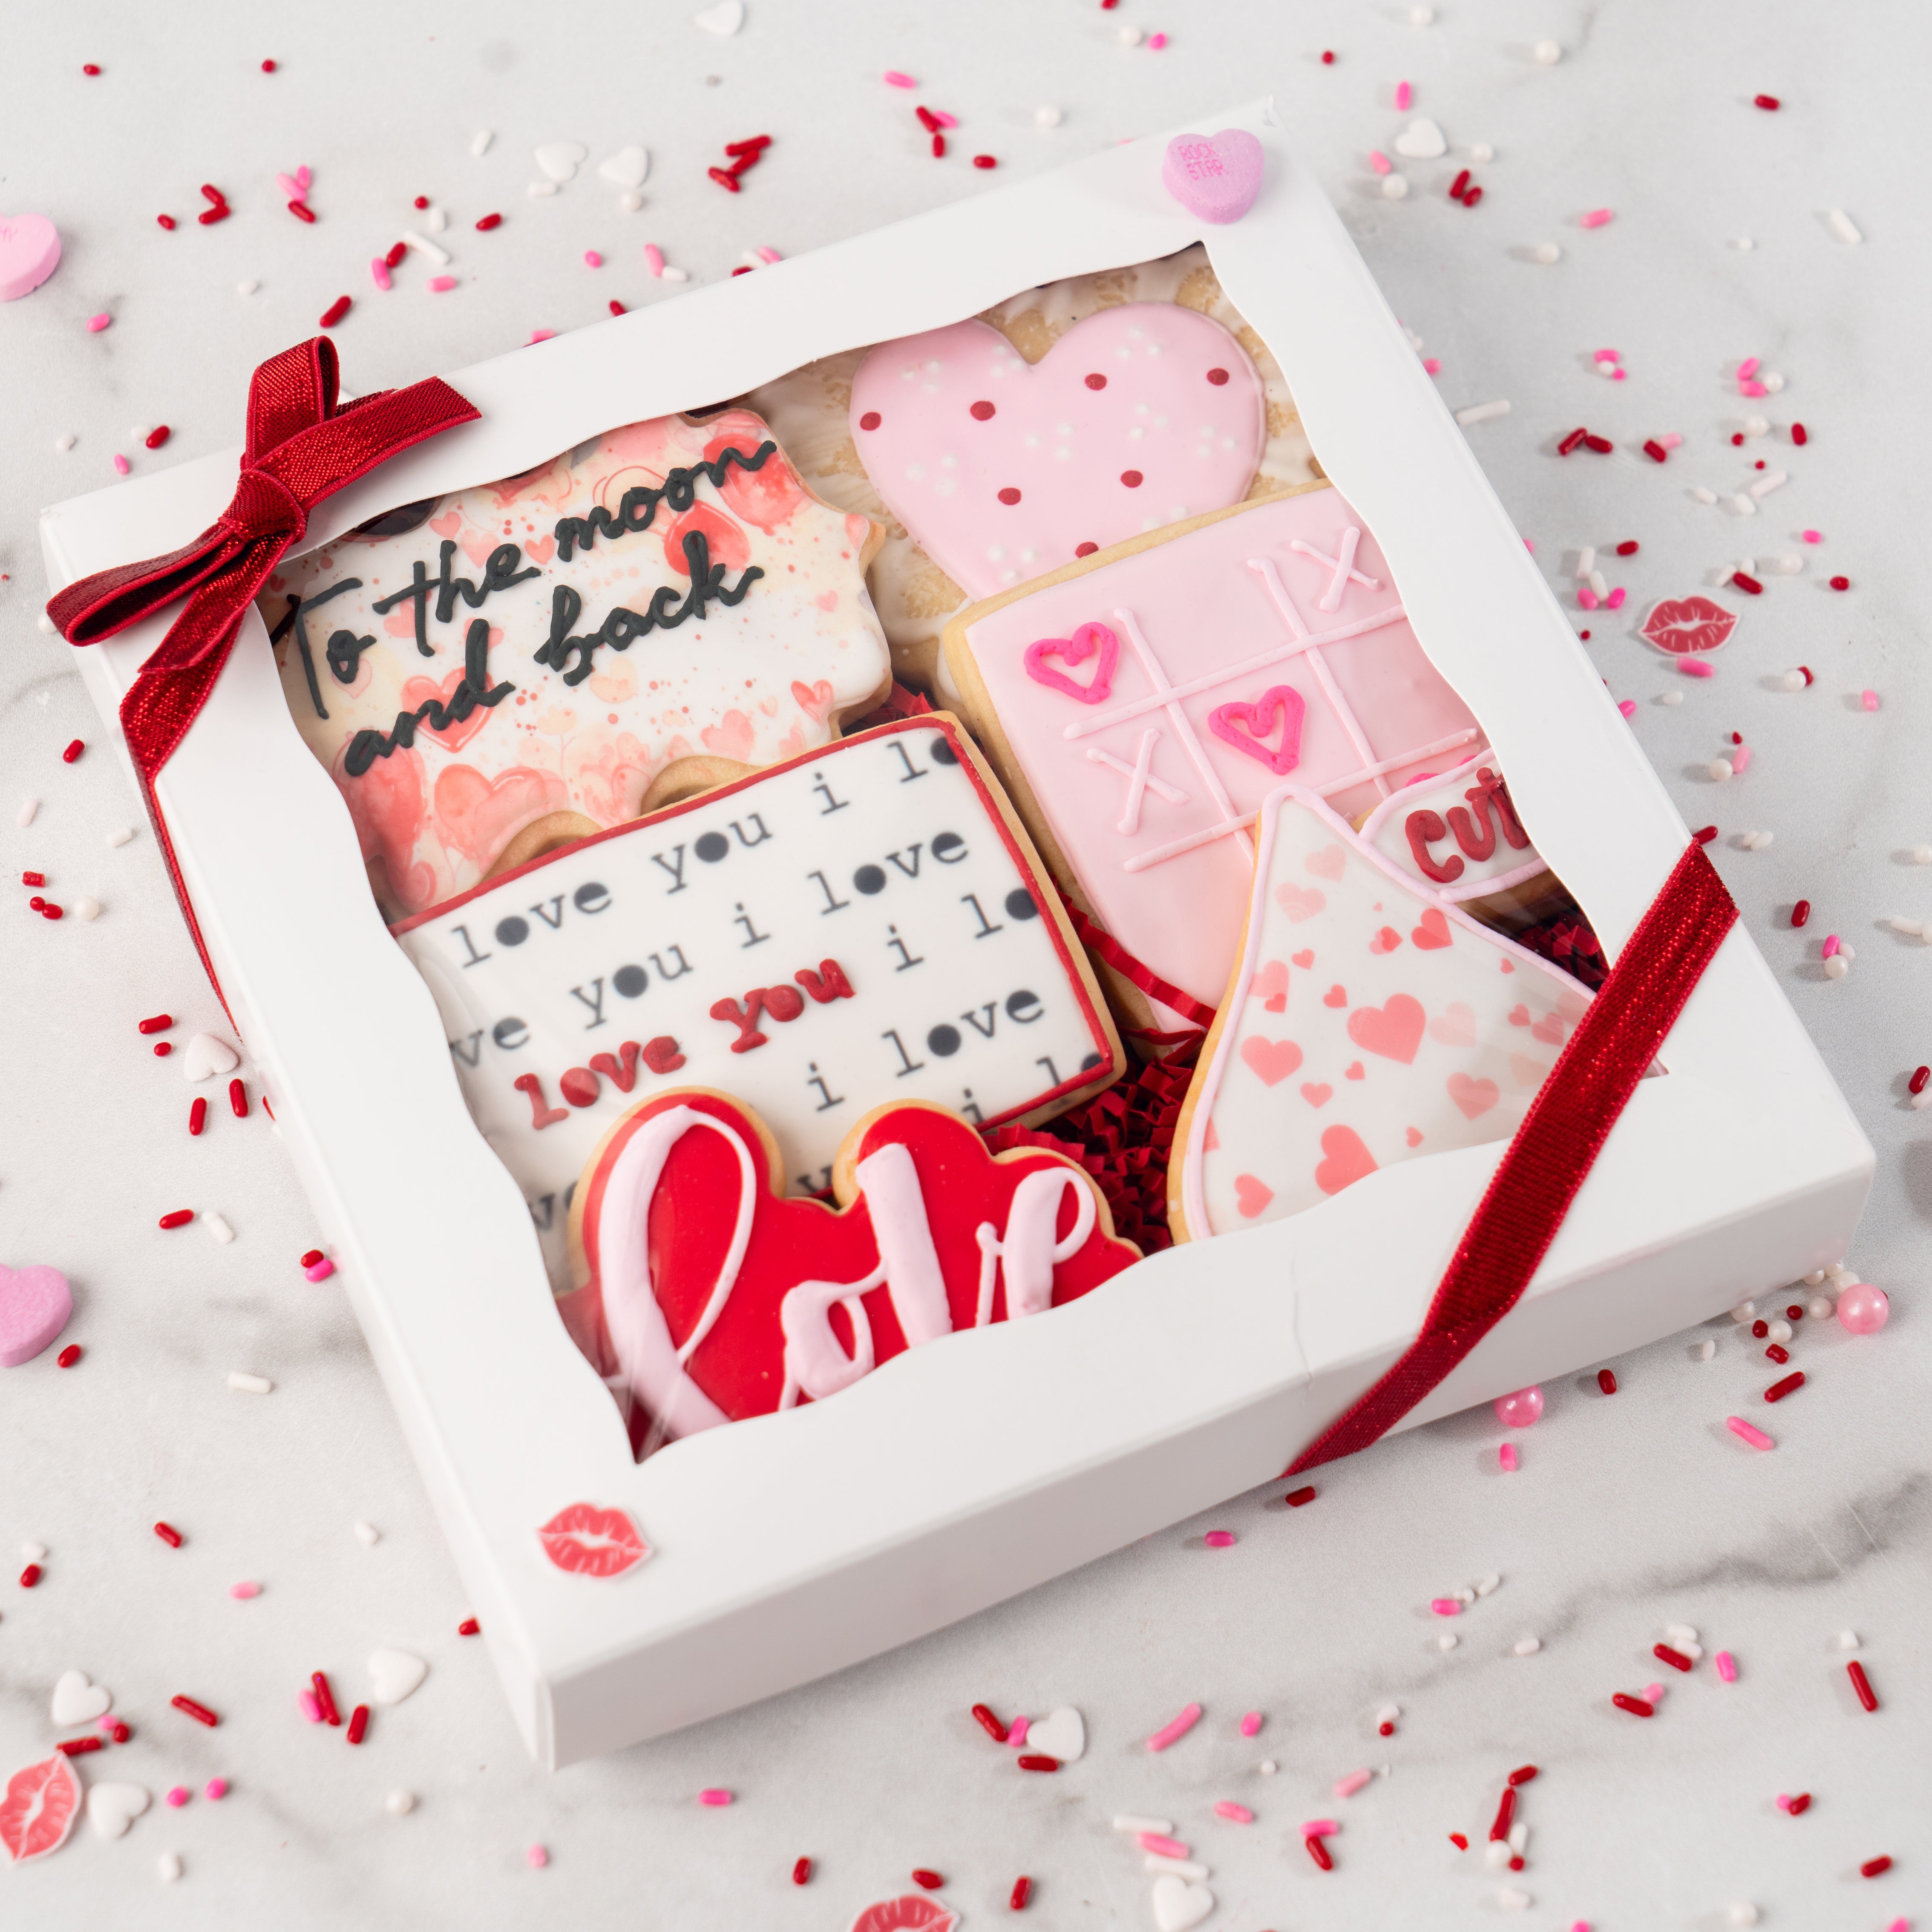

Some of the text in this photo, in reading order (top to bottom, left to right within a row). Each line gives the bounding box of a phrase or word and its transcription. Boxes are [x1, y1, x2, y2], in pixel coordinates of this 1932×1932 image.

[271, 440, 776, 719] To the moon
[345, 530, 764, 776] and back
[451, 882, 612, 967] love
[651, 812, 773, 894] you
[813, 772, 850, 815] i
[570, 945, 693, 1030] you
[732, 901, 771, 949] i
[807, 832, 969, 916] love
[514, 1035, 686, 1130] love
[710, 958, 856, 1054] you
[885, 924, 924, 972] i
[807, 1062, 845, 1112] i
[881, 990, 1045, 1078] love
[596, 1105, 1097, 1438] love
